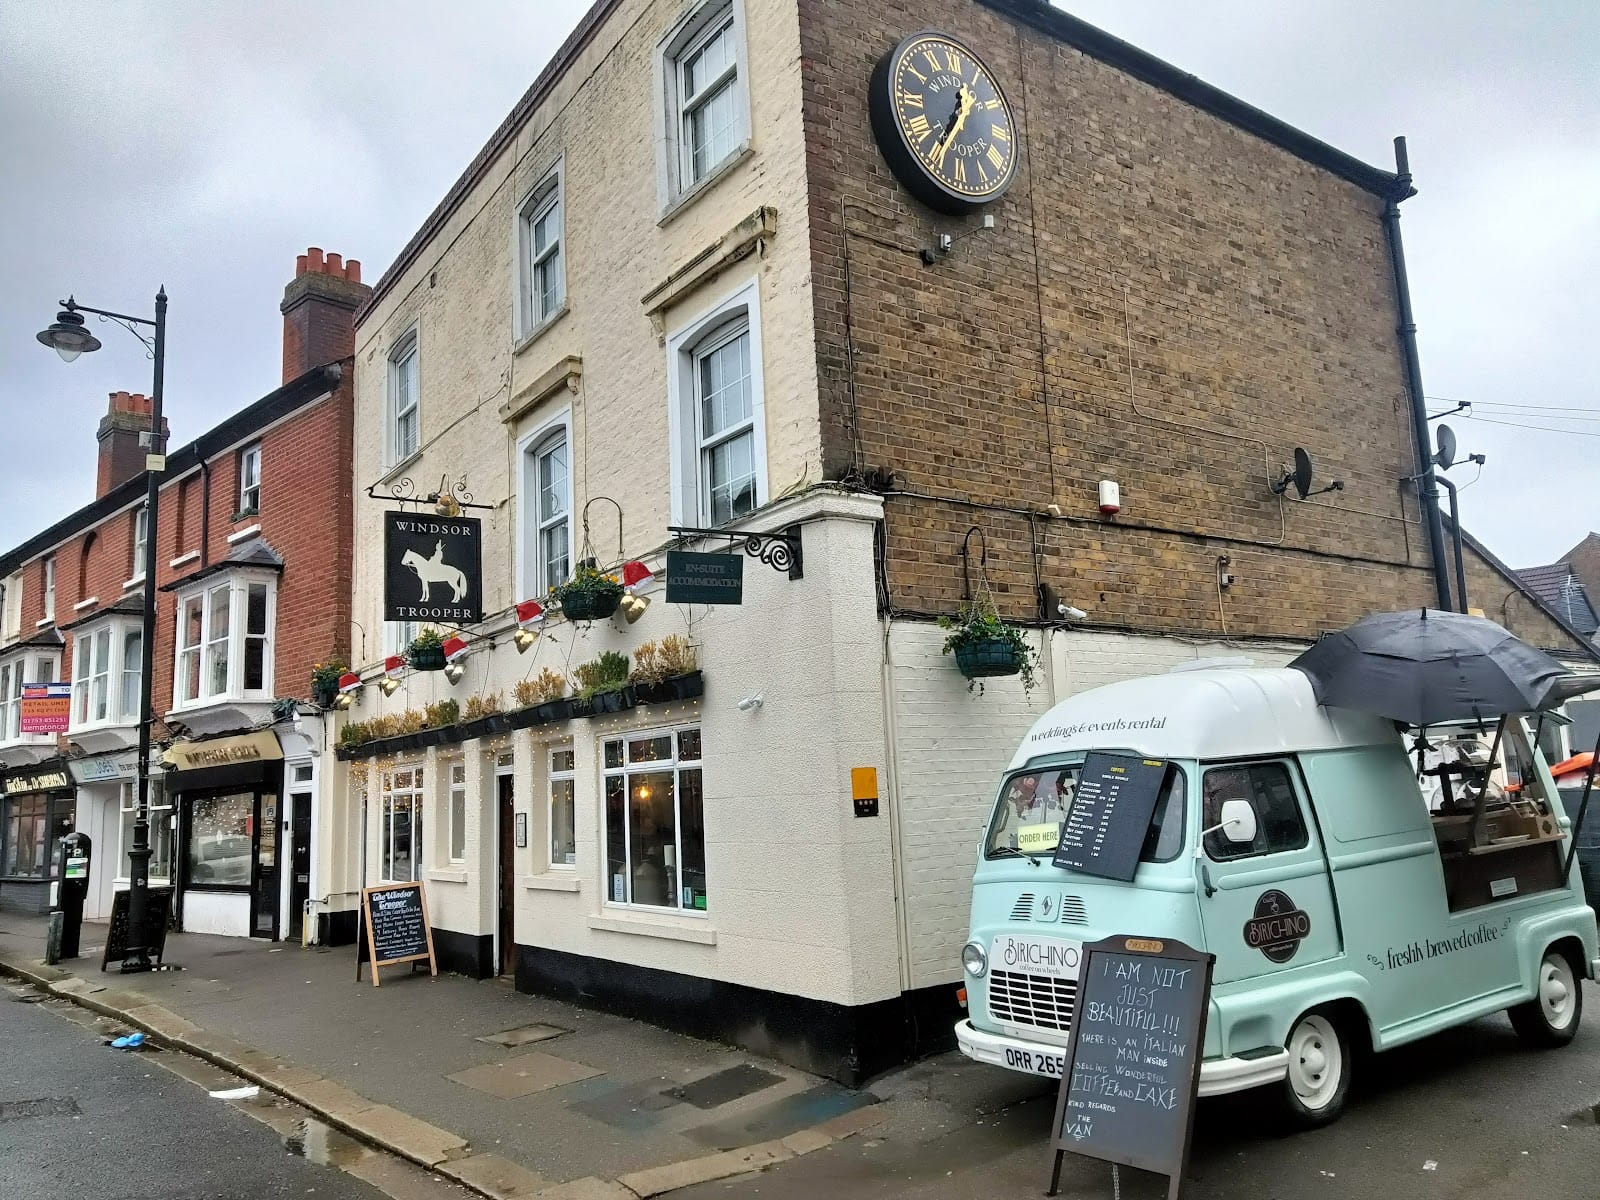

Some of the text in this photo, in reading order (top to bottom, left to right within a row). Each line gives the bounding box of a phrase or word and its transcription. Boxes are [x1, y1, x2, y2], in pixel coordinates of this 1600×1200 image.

[907, 63, 928, 85] X
[928, 74, 984, 112] WINDOR
[396, 521, 471, 536] WINDSOR
[396, 606, 472, 619] TROOPER
[1031, 716, 1168, 742] weddings & events rental
[1019, 833, 1041, 843] ORDER
[1042, 831, 1058, 841] HERE
[1249, 915, 1308, 945] BIRICHINO
[1426, 929, 1467, 959] brewed
[1467, 923, 1498, 947] coffee
[1004, 938, 1079, 968] BIRICHINO
[1151, 965, 1192, 990] NOT
[1117, 983, 1159, 1010] JUST
[1081, 1033, 1187, 1057] THERE IS AN ITALIAN
[1005, 1048, 1033, 1071] ORR
[1116, 1047, 1168, 1067] MAN INSIDE
[1075, 1062, 1168, 1085] SELLING WONDERFUL
[1071, 1073, 1178, 1110] COFFEE AND CAKE
[1068, 1099, 1117, 1113] KIND REGARDS
[1065, 1122, 1094, 1137] VAN
[1077, 1114, 1092, 1123] THE
